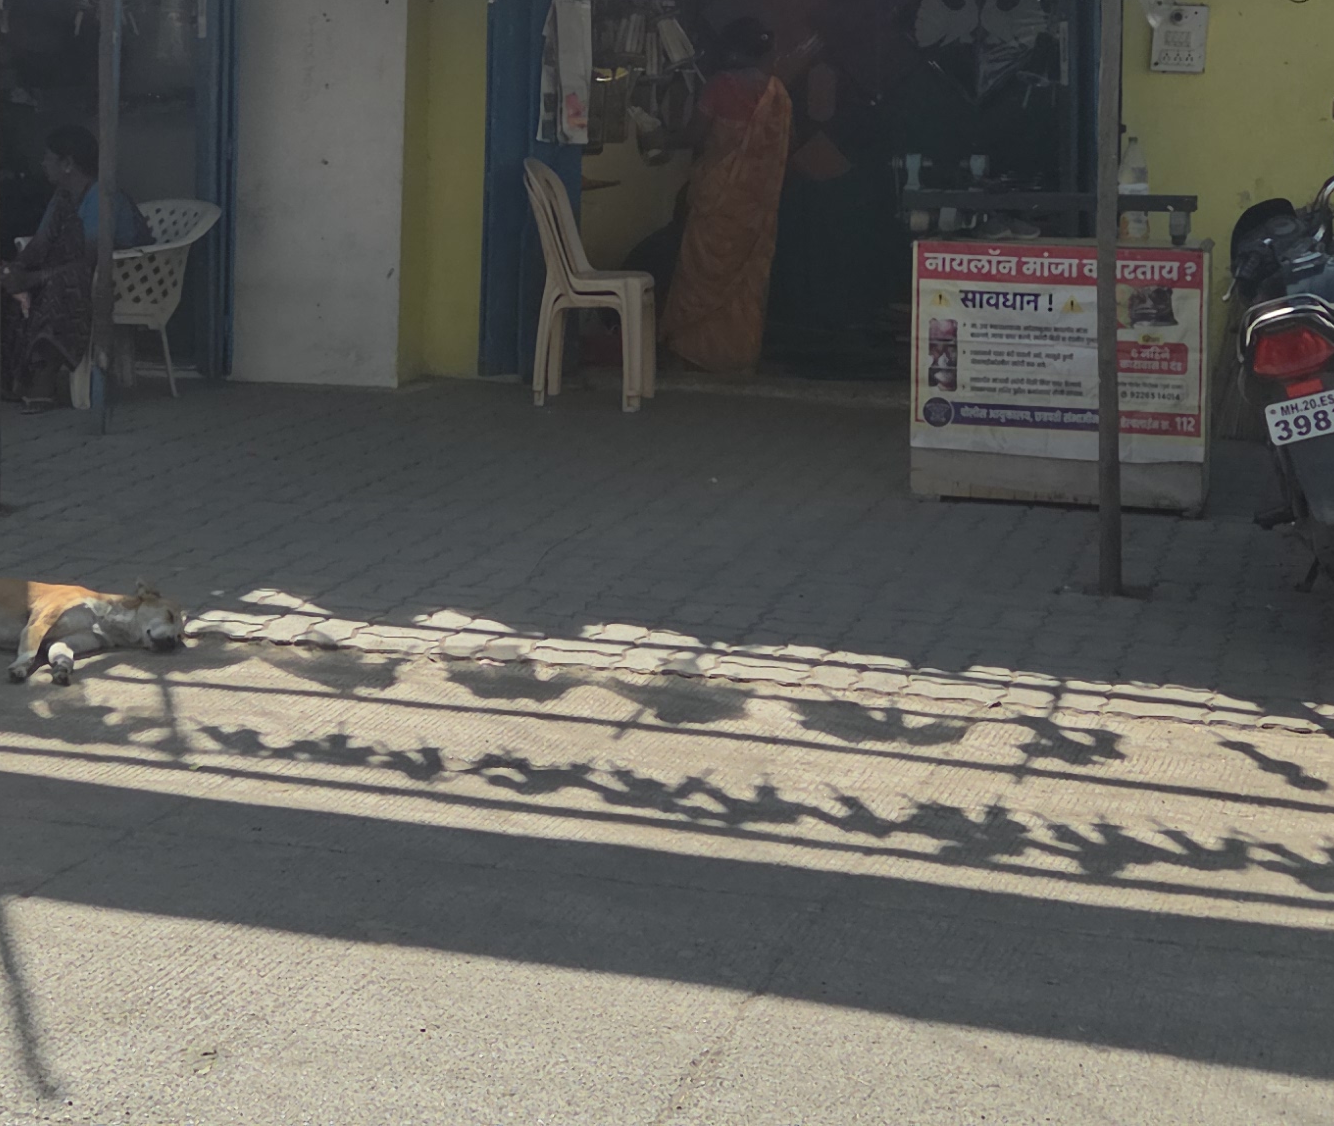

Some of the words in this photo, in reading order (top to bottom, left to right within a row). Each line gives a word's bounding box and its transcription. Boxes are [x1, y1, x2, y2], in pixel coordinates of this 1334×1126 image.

[924, 249, 1018, 276] नायलॉन
[1021, 251, 1079, 278] मांजा
[1083, 258, 1180, 281] वरताय
[1185, 261, 1198, 282] ?
[959, 289, 1041, 312] सावधान
[1280, 393, 1334, 417] MH.20.ES
[1175, 416, 1196, 432] 112
